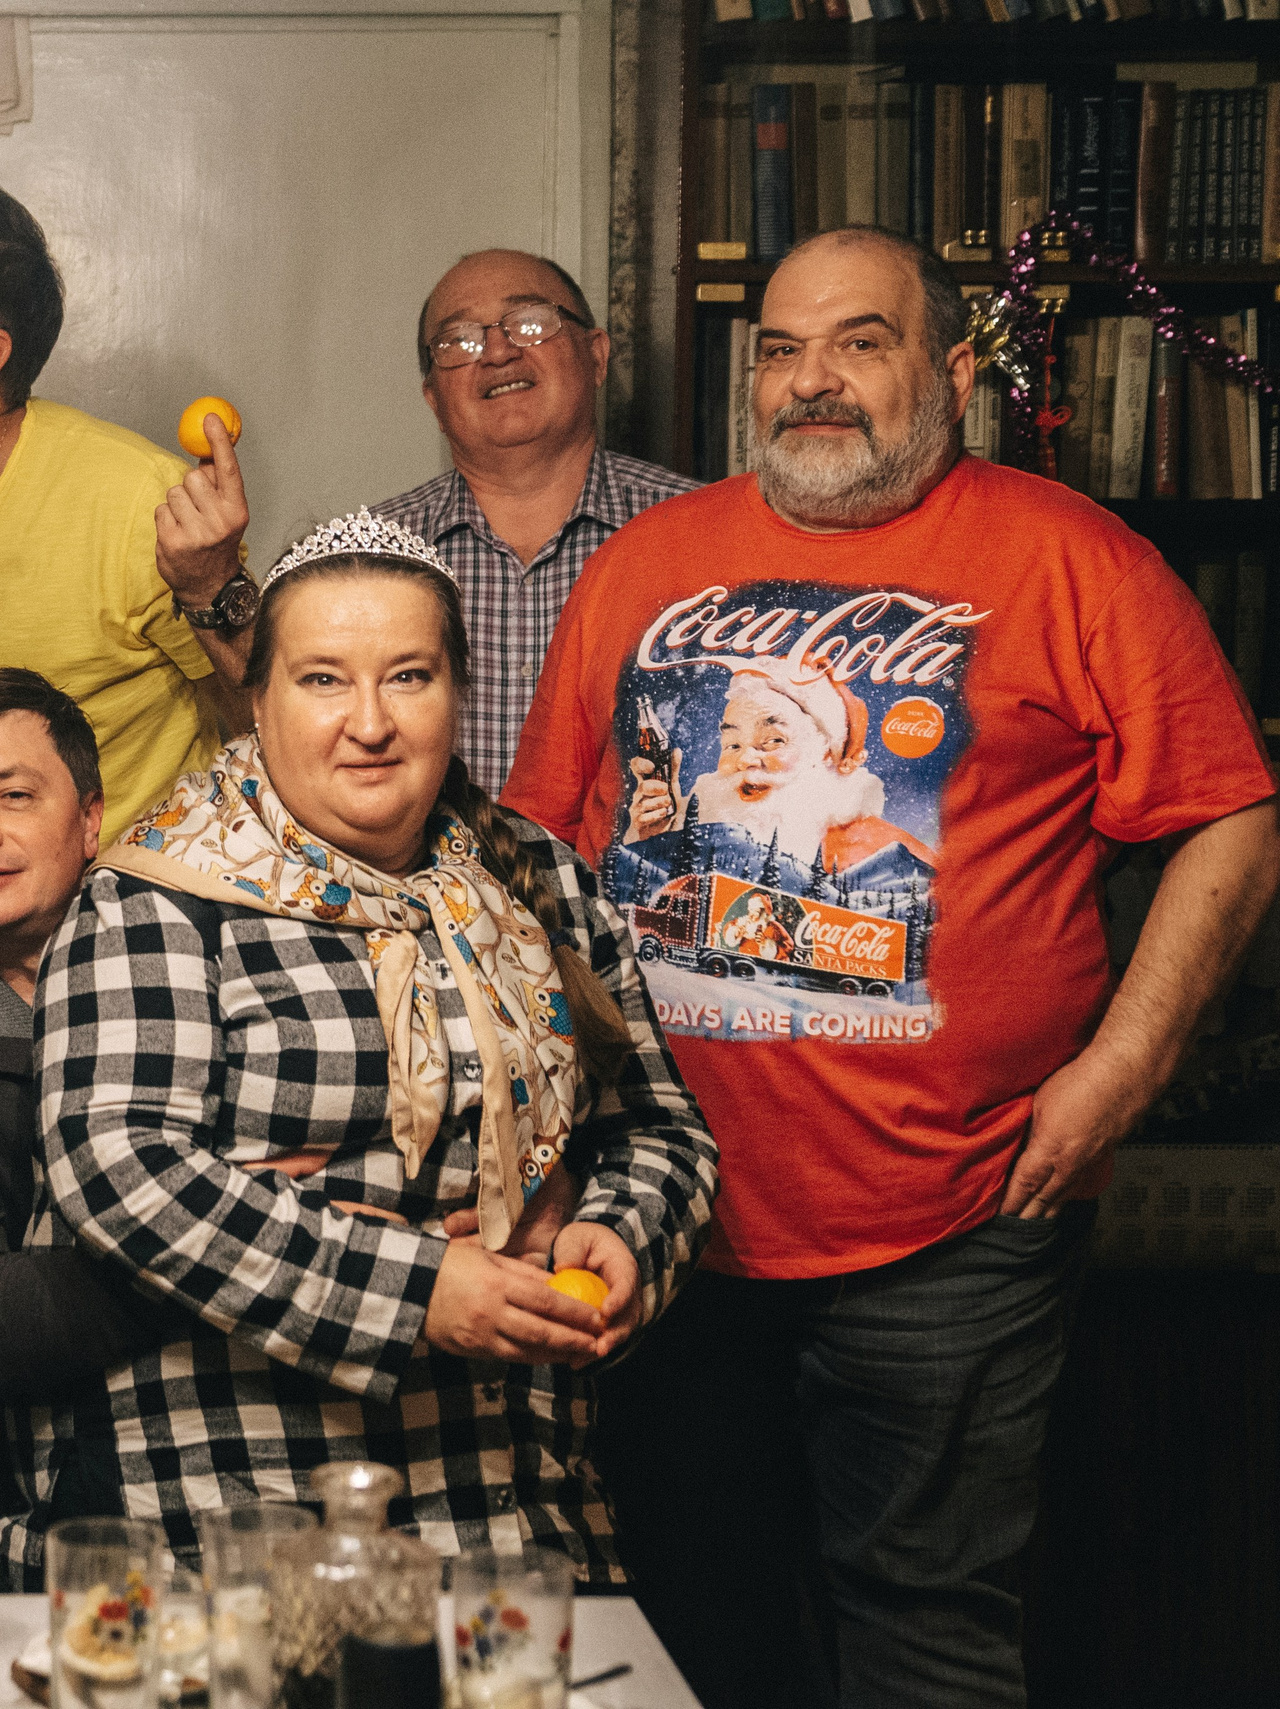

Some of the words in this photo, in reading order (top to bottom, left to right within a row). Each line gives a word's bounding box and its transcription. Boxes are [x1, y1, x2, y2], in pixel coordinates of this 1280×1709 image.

[637, 585, 994, 686] Coca-Cola
[794, 911, 896, 962] Coca-Cola
[793, 950, 842, 970] SANTA
[845, 960, 887, 977] PACKS
[731, 1007, 791, 1034] ARE
[802, 1011, 926, 1039] COMING
